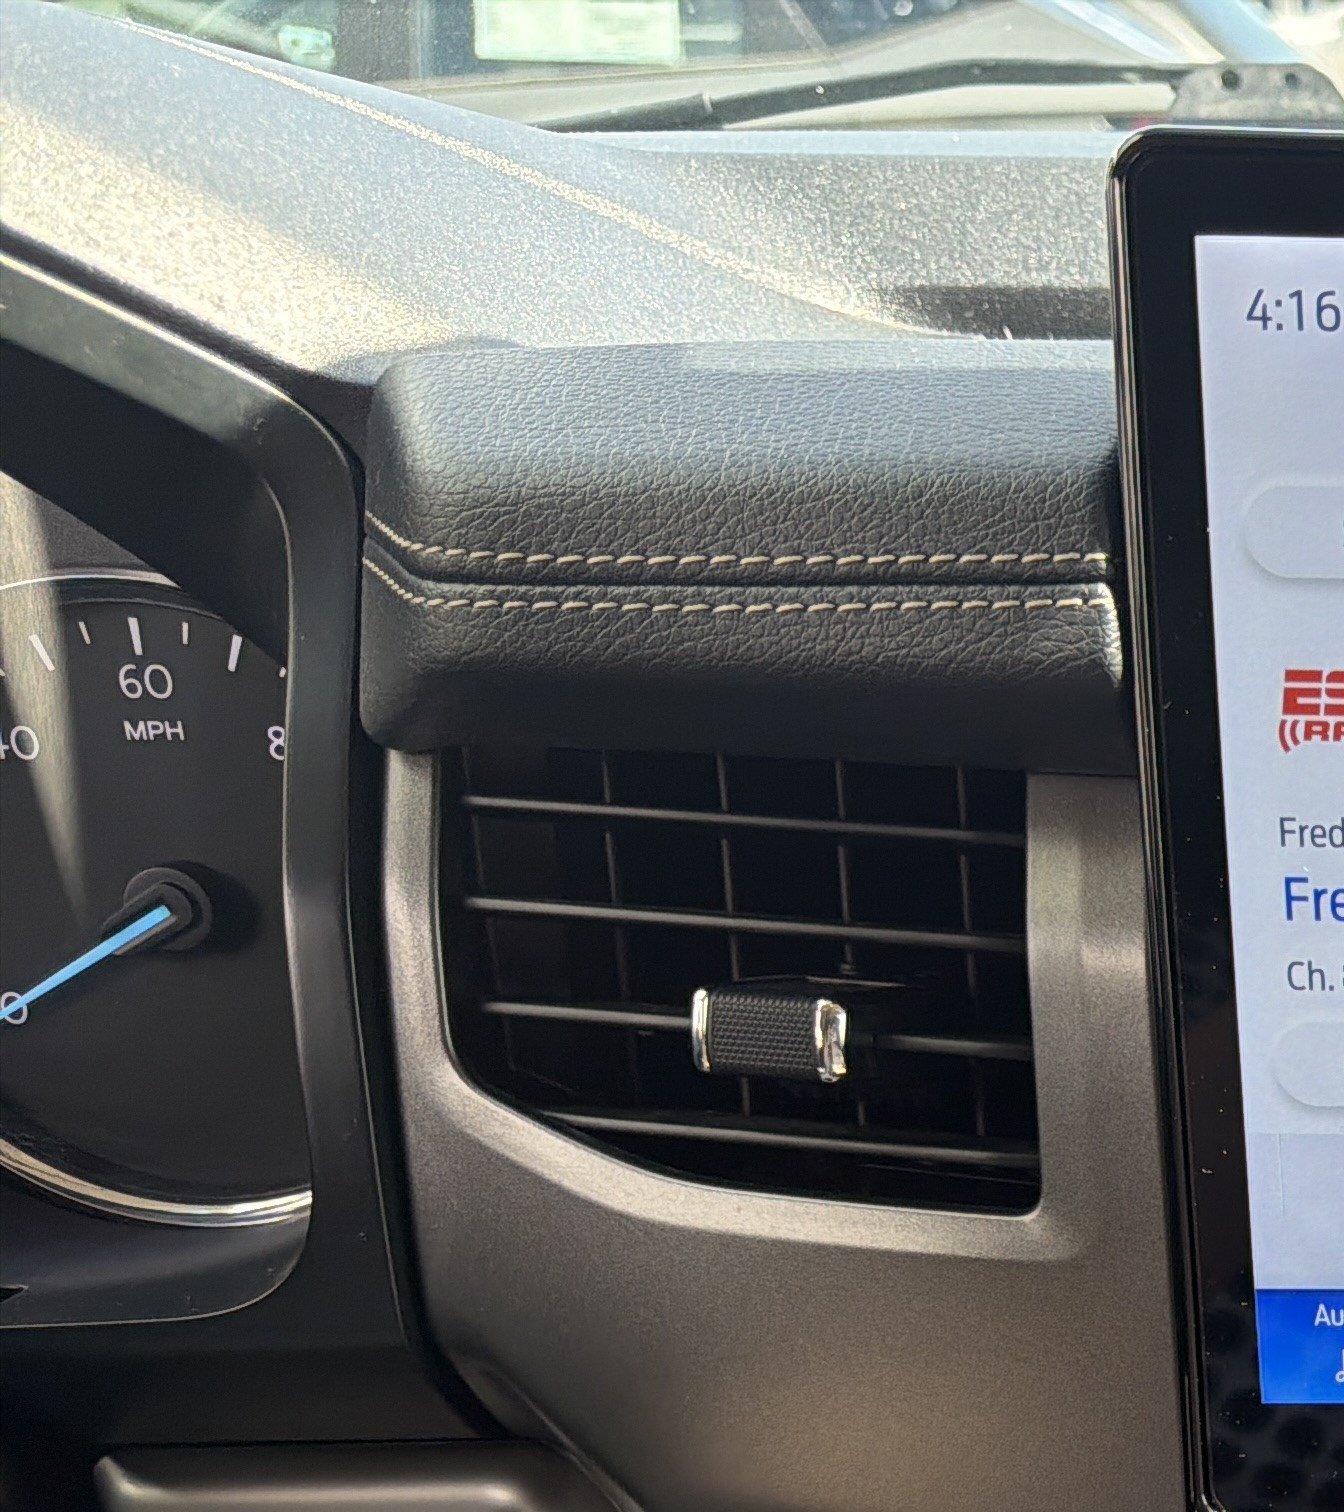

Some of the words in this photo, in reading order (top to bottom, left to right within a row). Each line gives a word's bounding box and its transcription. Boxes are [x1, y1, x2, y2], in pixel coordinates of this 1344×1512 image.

[1246, 288, 1341, 333] 4:16
[118, 663, 173, 700] 60
[123, 720, 185, 741] MPH
